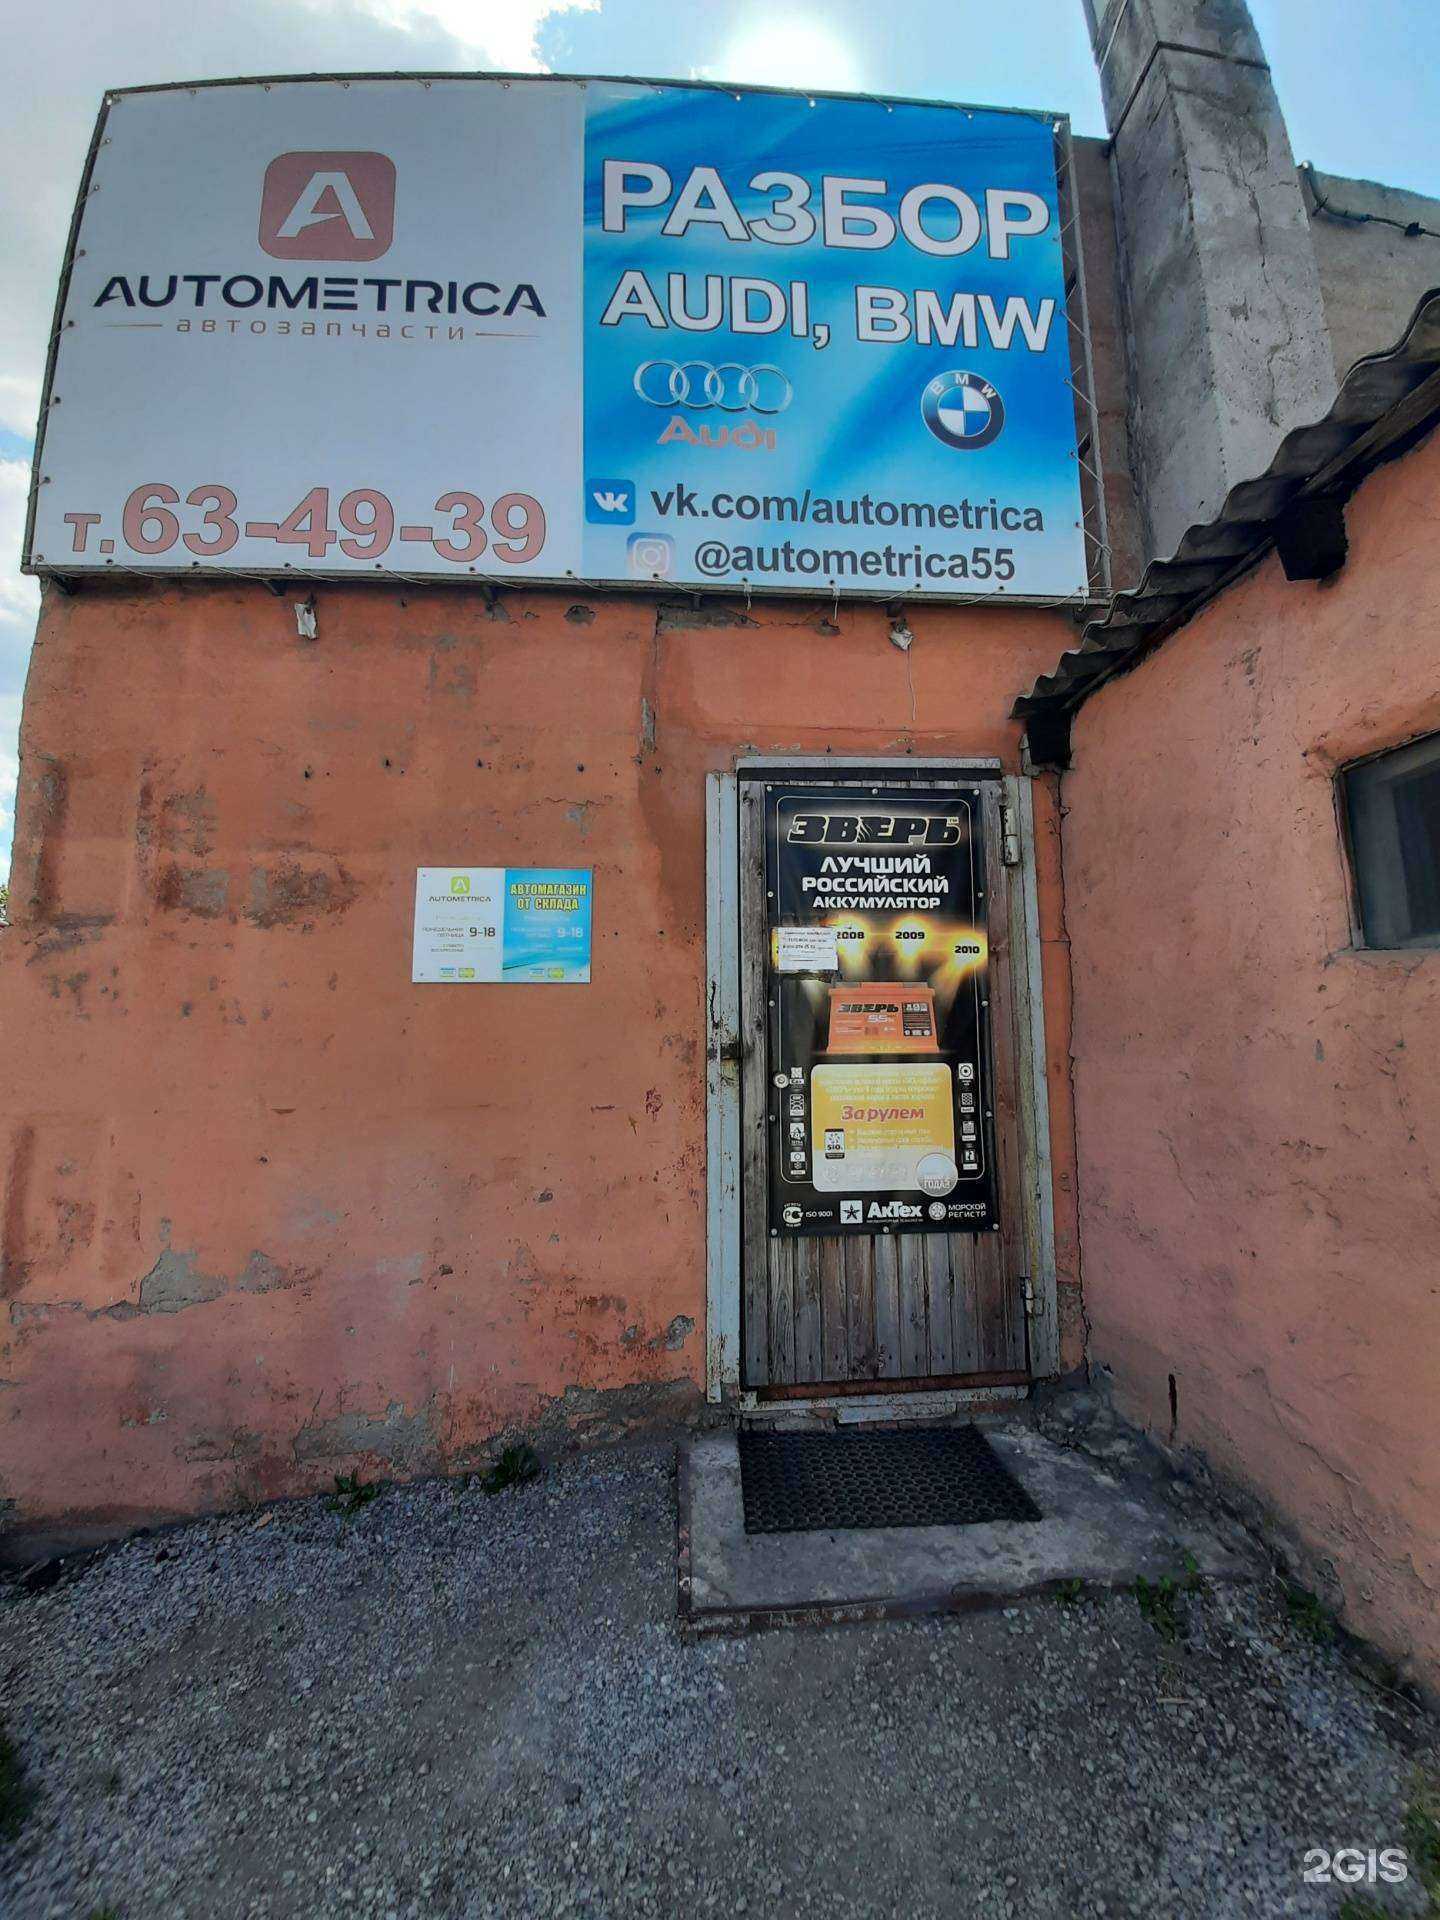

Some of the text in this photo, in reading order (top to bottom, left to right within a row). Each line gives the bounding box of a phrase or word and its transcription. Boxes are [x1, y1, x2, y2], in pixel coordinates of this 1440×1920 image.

[602, 159, 1051, 260] РАЗБОР
[93, 274, 548, 317] AUTOMETRICA
[601, 270, 1055, 352] AUDI, BMW
[175, 318, 465, 341] автозапчасти
[929, 372, 998, 400] BMW
[656, 414, 777, 451] Audi
[650, 483, 1044, 532] vk.com/autometrica
[694, 540, 1017, 581] @autometrica55
[787, 814, 961, 846] ЗВЕРЬ
[820, 854, 931, 874] ЛУЧШИЙ
[510, 883, 587, 896] АВТОМАГАЗИН
[802, 875, 949, 894] РОССИЙСКИЙ
[428, 895, 492, 903] AUTOMETRICA
[517, 898, 579, 911] ОТ СКЛАДА
[812, 896, 941, 909] АККУМУЛЯТОР
[469, 926, 497, 938] 9-18
[557, 926, 584, 938] 9-18
[895, 931, 925, 940] 2009
[954, 944, 981, 954] 2010
[948, 1202, 986, 1211] МОРСКОЙ
[948, 1210, 986, 1218] РЕГИСТР
